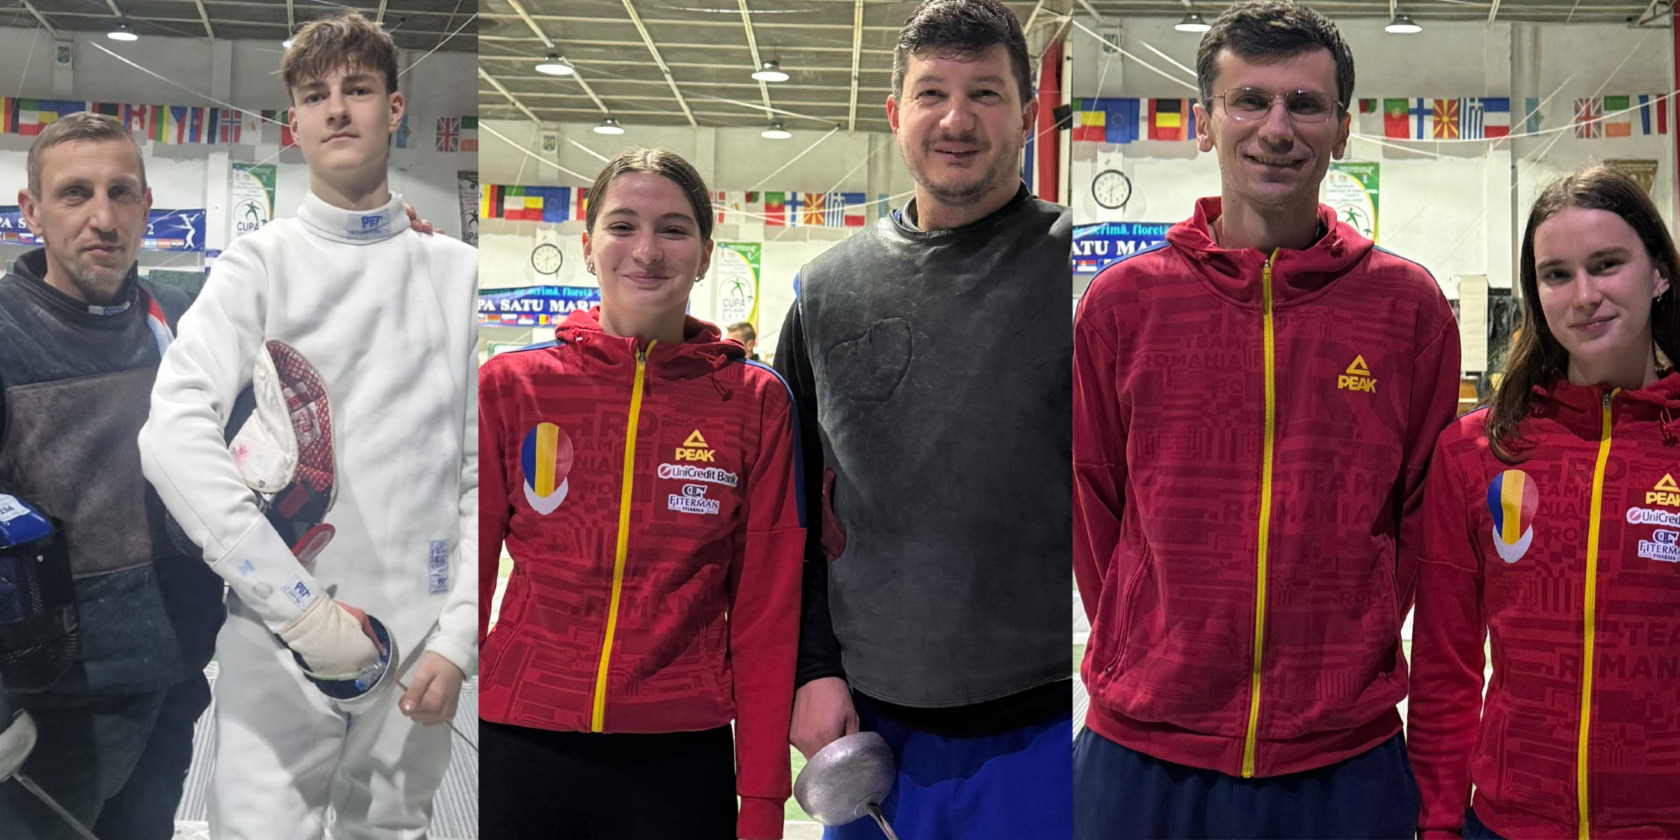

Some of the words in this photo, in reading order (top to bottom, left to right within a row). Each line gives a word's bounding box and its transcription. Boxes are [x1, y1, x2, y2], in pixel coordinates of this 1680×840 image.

[237, 221, 259, 231] CUPA
[501, 299, 544, 312] SATU
[723, 298, 745, 307] CUPA
[1337, 374, 1377, 393] PEAK
[675, 447, 716, 462] PEAK
[672, 466, 716, 480] UniCredit
[718, 470, 737, 485] Bank
[669, 495, 718, 509] FITERMAN
